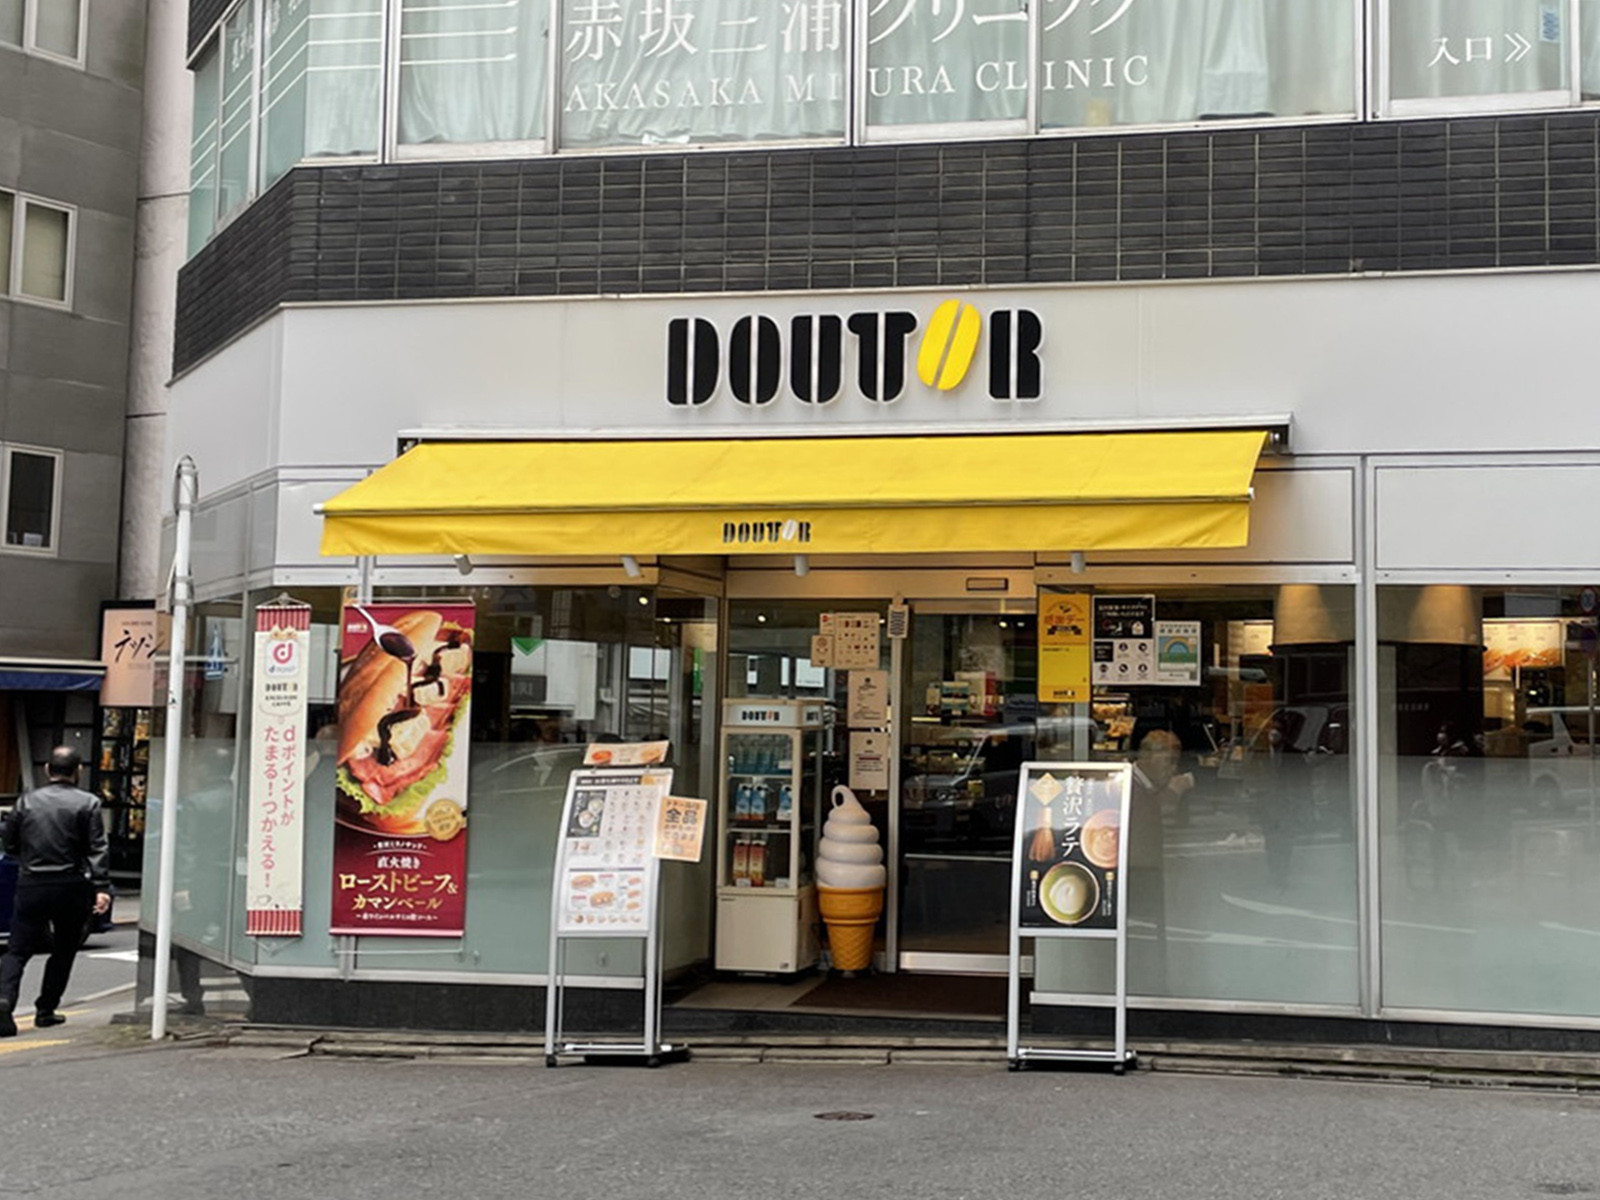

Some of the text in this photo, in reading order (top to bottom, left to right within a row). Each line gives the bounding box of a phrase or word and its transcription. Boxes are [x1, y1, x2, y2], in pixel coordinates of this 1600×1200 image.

[1427, 36, 1492, 68] 入口
[564, 55, 1149, 112] AKASAKA MIURA CLINIC
[667, 299, 1043, 407] DOUTOR
[723, 519, 811, 543] DOUTOR
[1062, 775, 1085, 858] 贅沢ラテ
[351, 893, 443, 911] カマンベール
